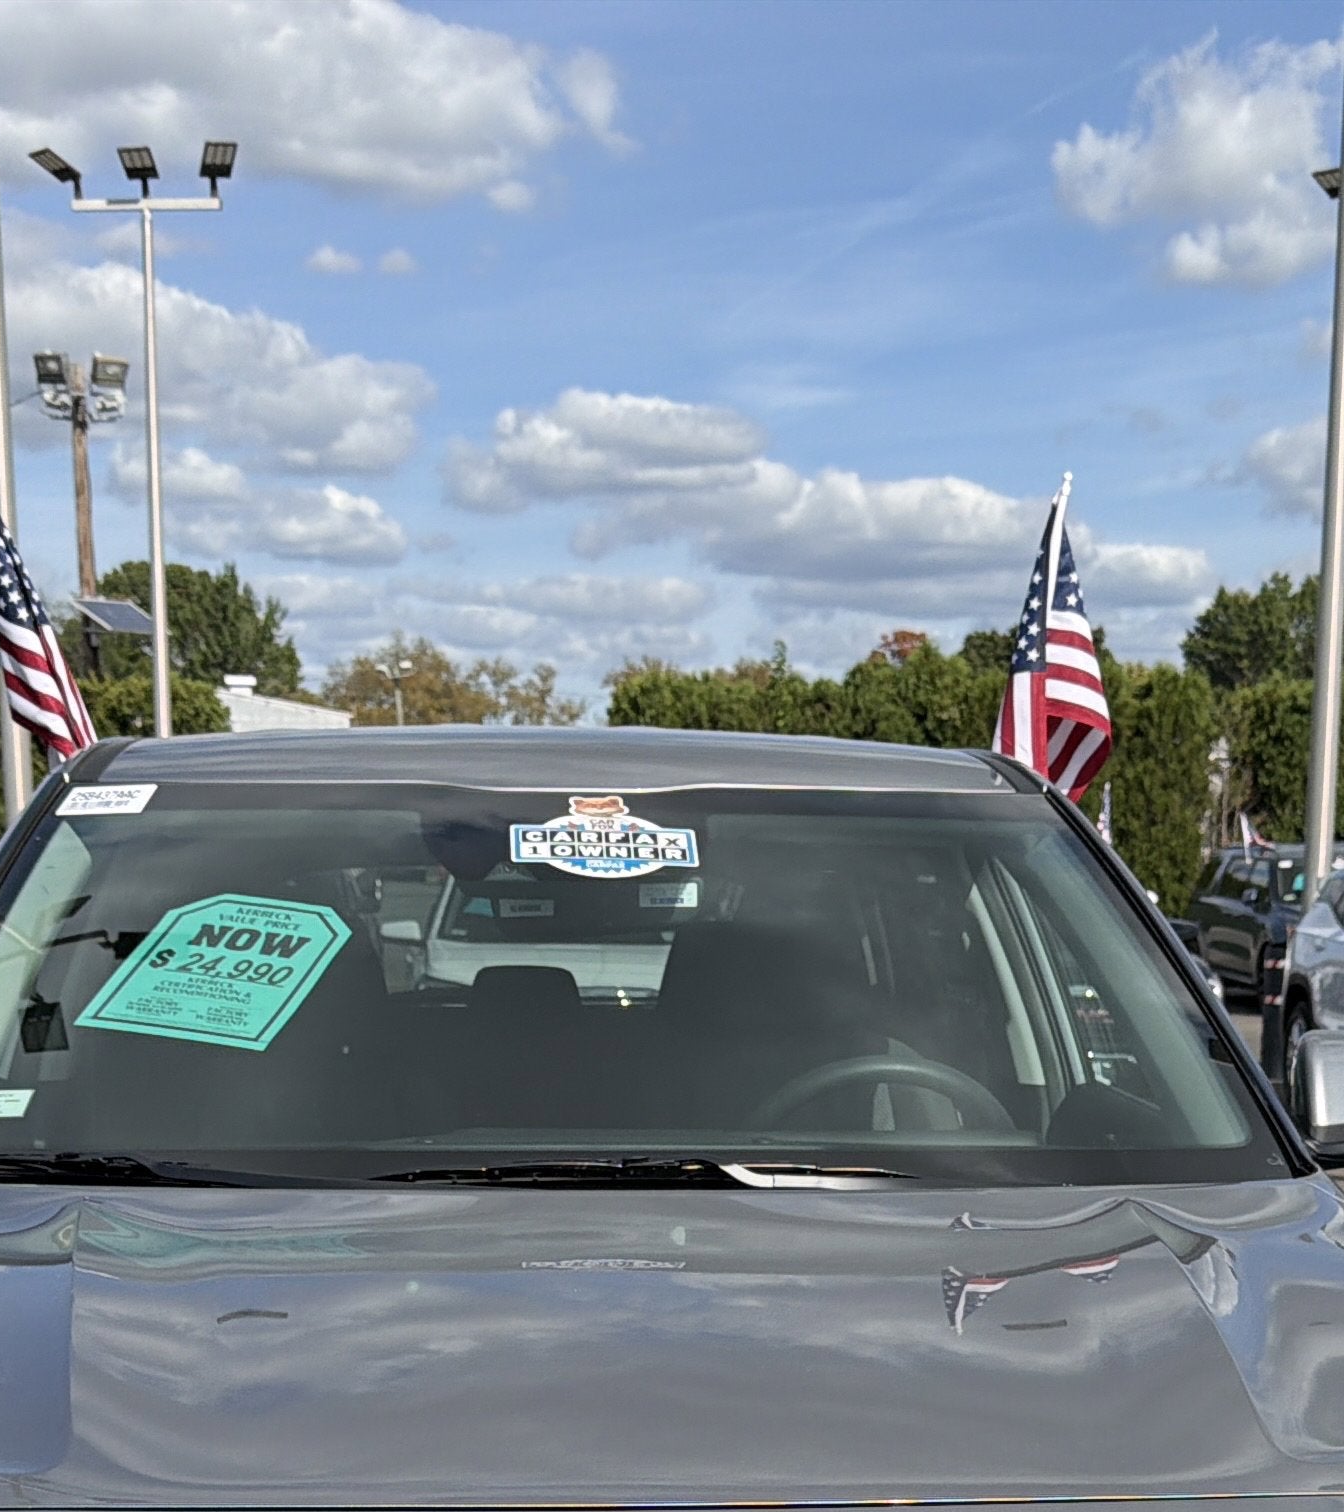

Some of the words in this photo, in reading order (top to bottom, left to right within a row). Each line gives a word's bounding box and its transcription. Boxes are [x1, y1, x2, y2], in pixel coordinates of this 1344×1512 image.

[525, 831, 680, 847] CARFAX
[529, 846, 542, 855] 1
[554, 846, 683, 860] OWNER
[219, 913, 256, 925] VALUE
[263, 919, 302, 931] PRICE
[237, 907, 292, 921] KERBECK
[186, 923, 312, 959] NOW
[148, 949, 176, 968] $
[176, 953, 294, 985] 24,990
